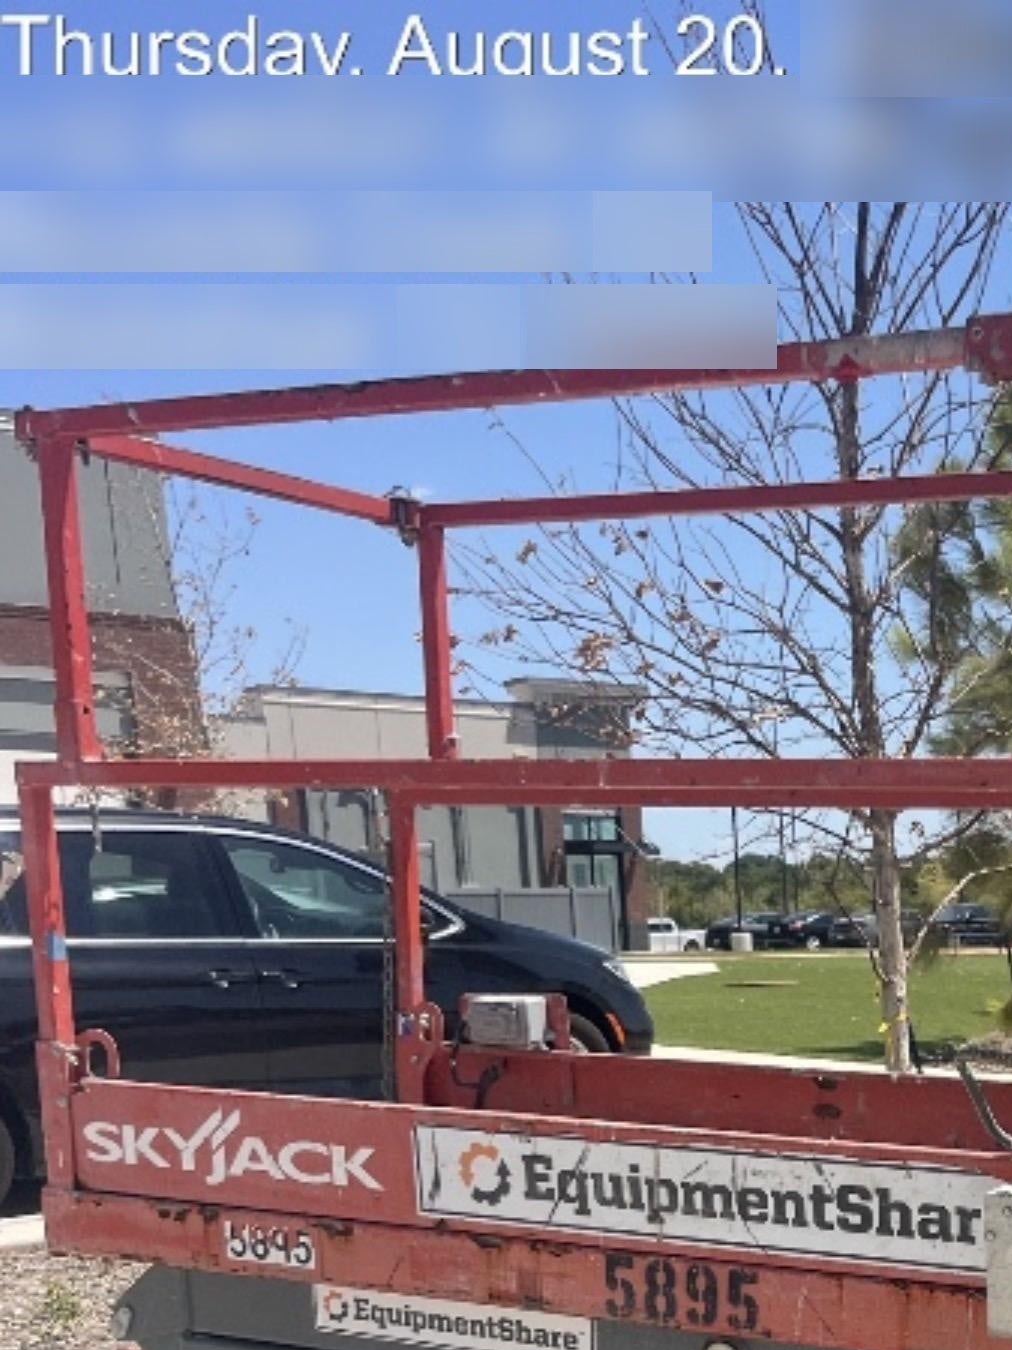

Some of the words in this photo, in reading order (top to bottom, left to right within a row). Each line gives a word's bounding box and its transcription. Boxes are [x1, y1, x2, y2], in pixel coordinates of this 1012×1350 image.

[82, 1106, 384, 1191] SKYJACK
[521, 1154, 983, 1245] EquipmentShar
[229, 1223, 313, 1265] 5895
[605, 1255, 761, 1330] 5895
